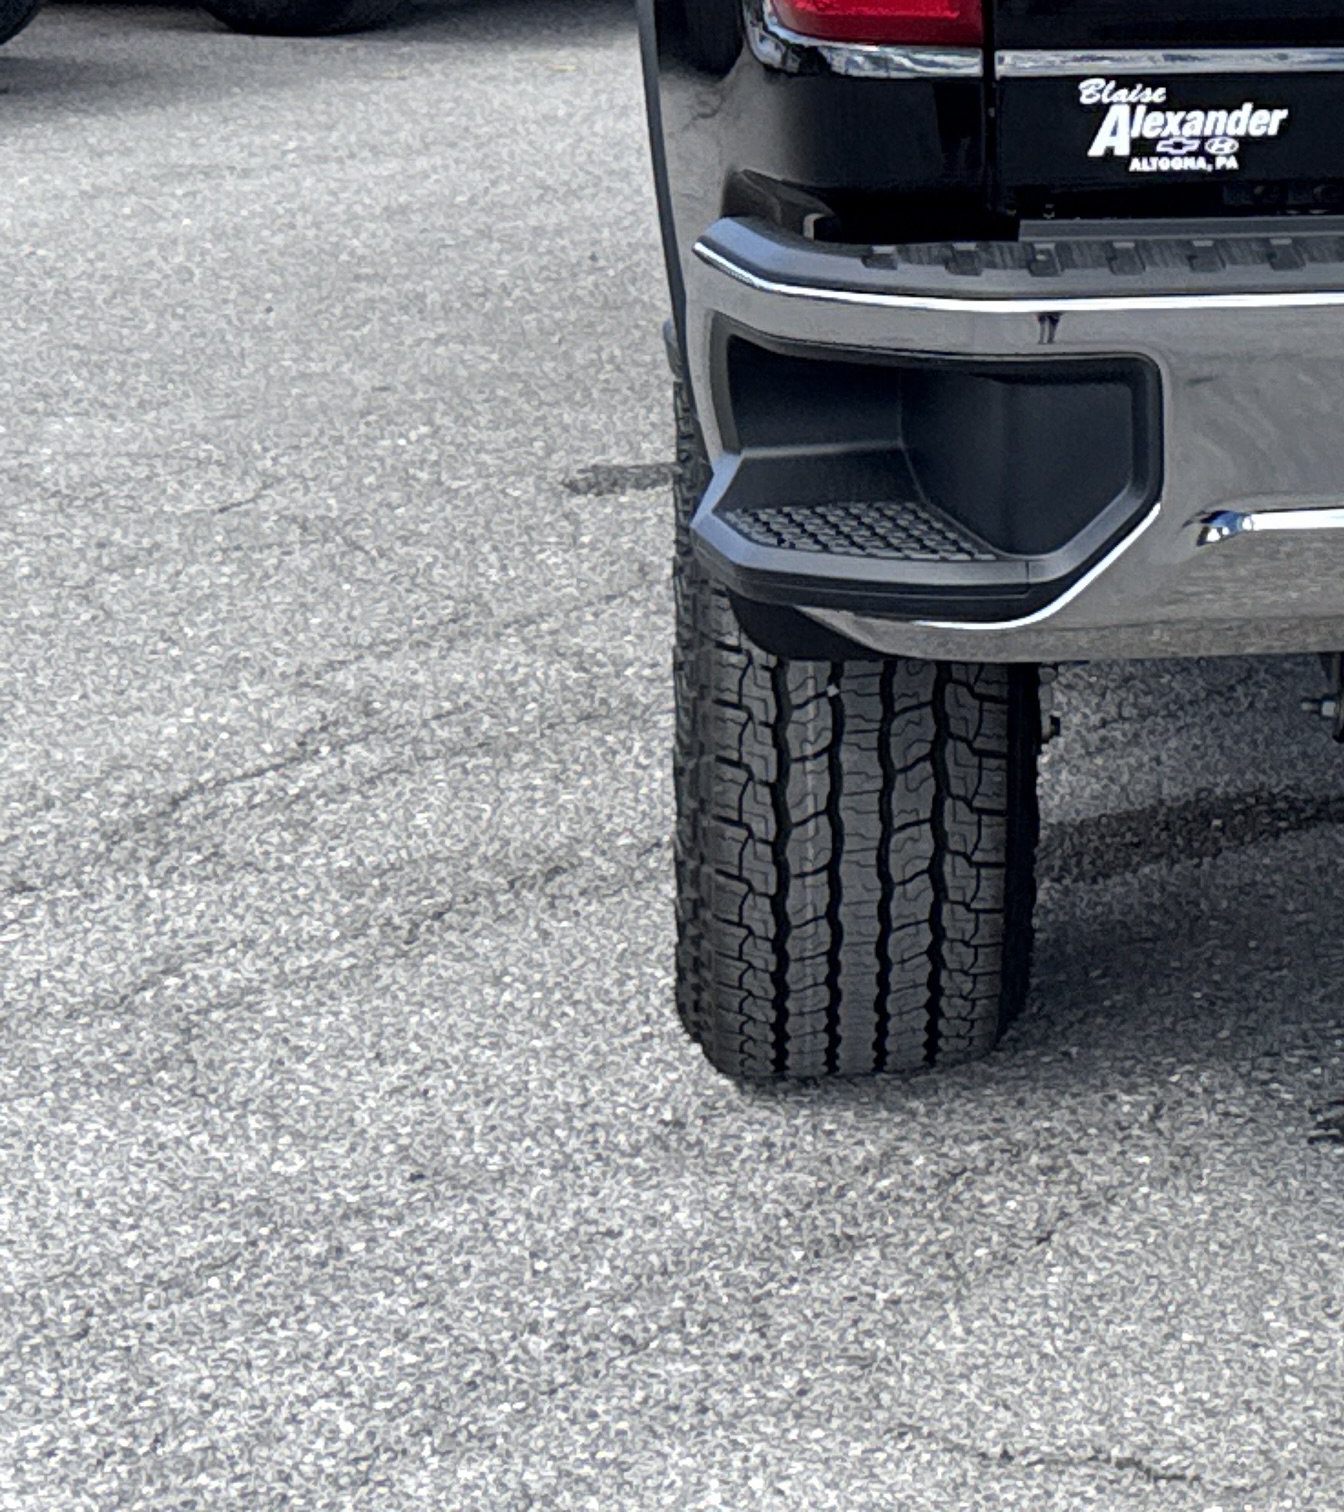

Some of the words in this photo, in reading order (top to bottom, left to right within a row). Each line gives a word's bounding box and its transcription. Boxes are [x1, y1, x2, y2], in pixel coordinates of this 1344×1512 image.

[1077, 77, 1168, 105] Blaise
[1086, 101, 1290, 157] Alexander
[1214, 155, 1239, 171] PA
